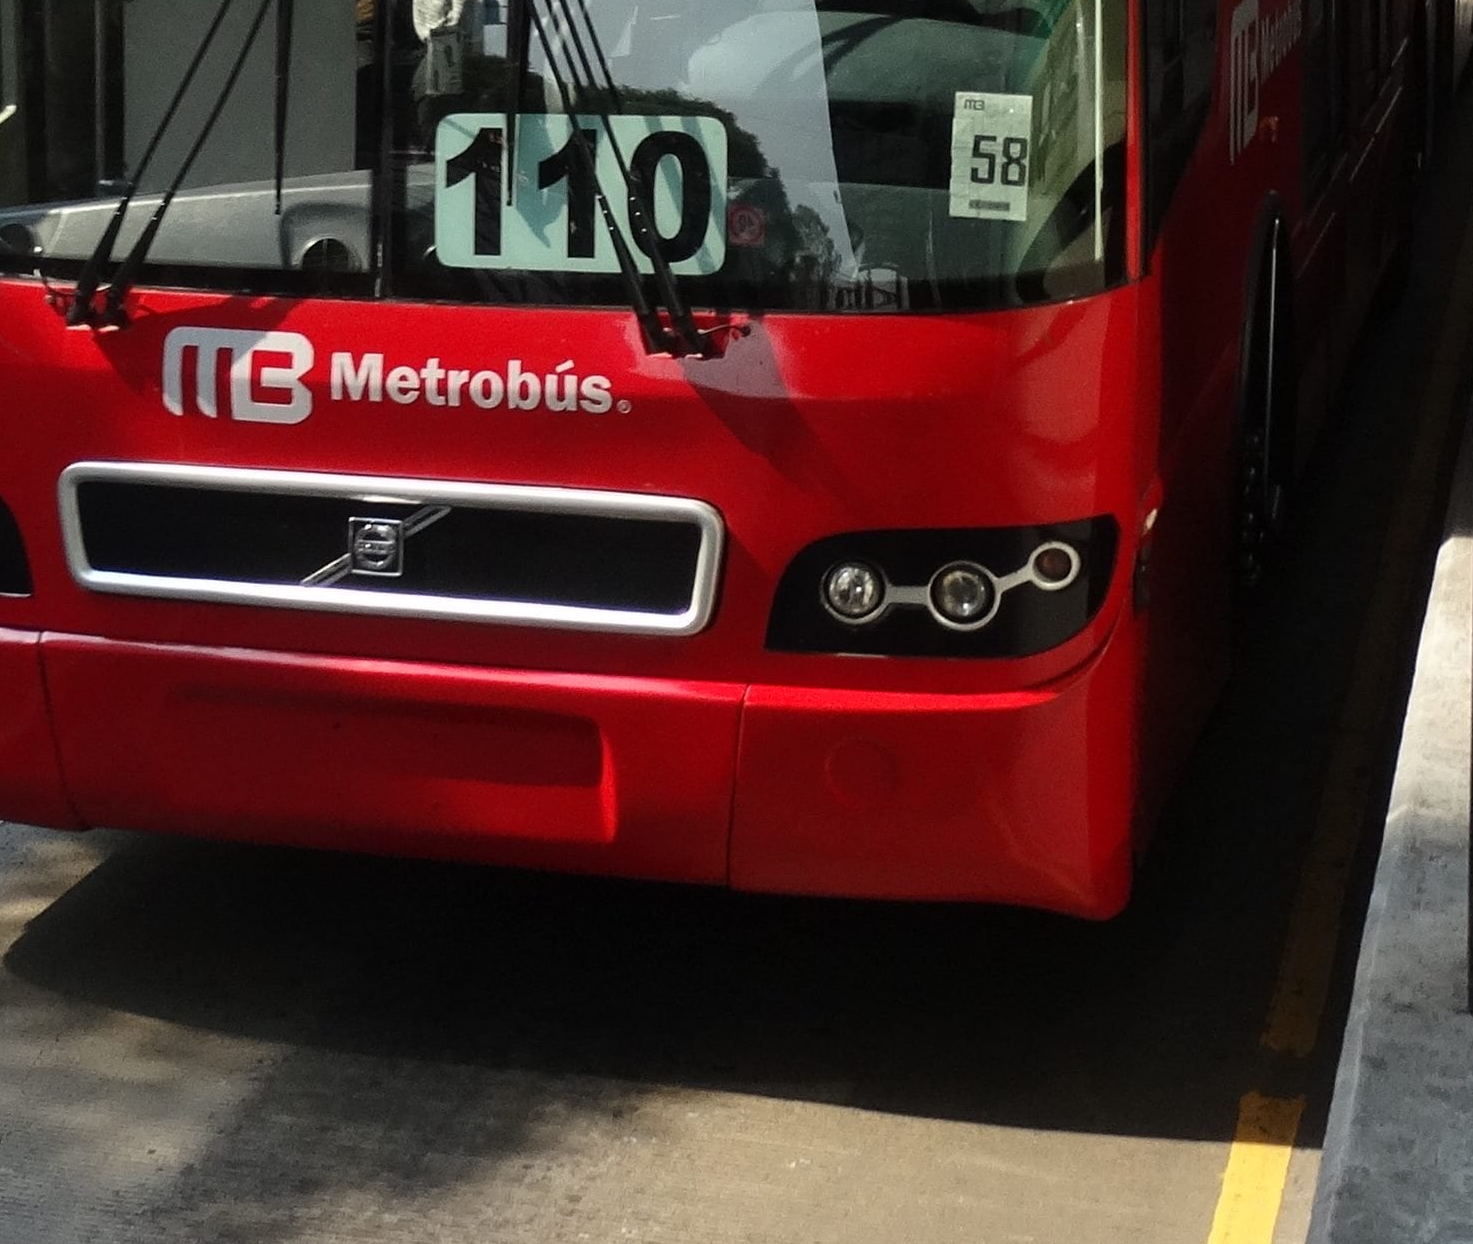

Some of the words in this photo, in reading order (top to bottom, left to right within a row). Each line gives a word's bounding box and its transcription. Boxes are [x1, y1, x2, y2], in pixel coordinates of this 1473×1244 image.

[970, 134, 1028, 187] 58
[445, 127, 711, 263] 110
[330, 351, 614, 415] Metrobús
